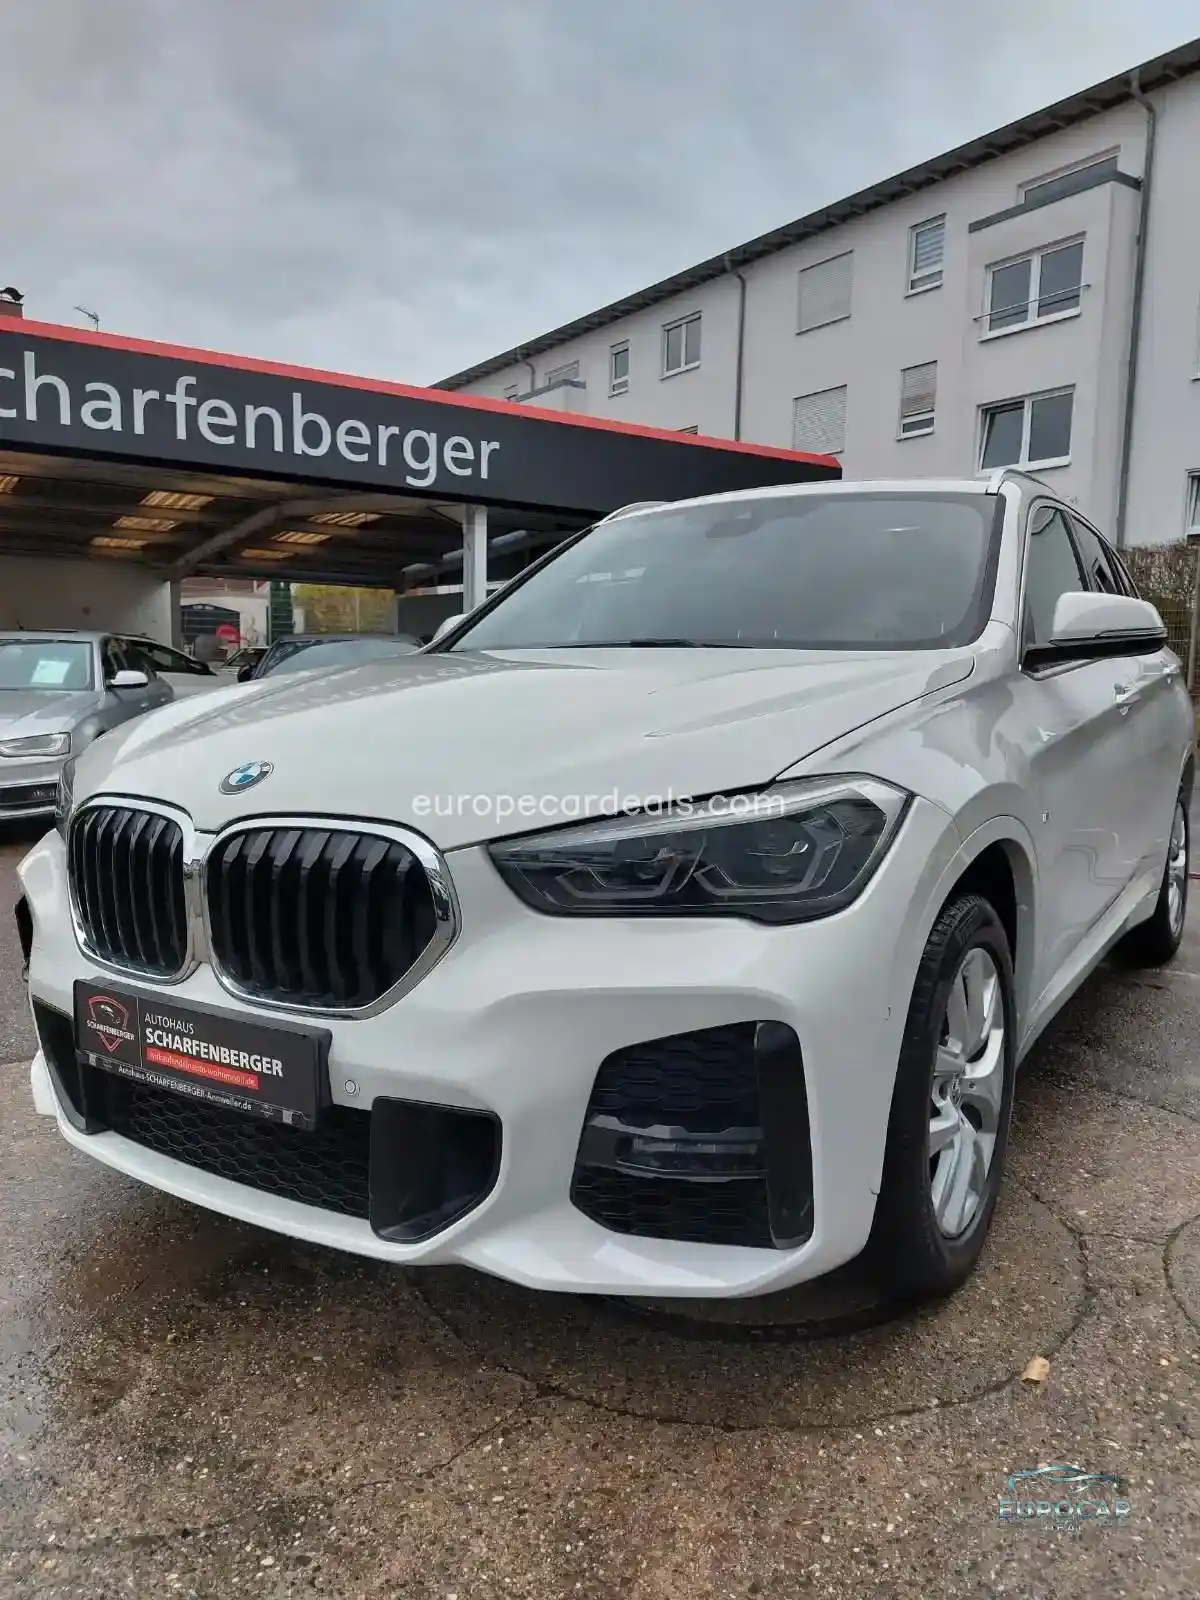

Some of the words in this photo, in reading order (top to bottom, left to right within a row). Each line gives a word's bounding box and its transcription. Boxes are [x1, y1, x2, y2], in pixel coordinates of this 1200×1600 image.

[86, 1019, 135, 1041] SCHARFENBERGER
[144, 1012, 195, 1035] AUTOHAUS
[145, 1028, 284, 1077] SCHARFENBERGER
